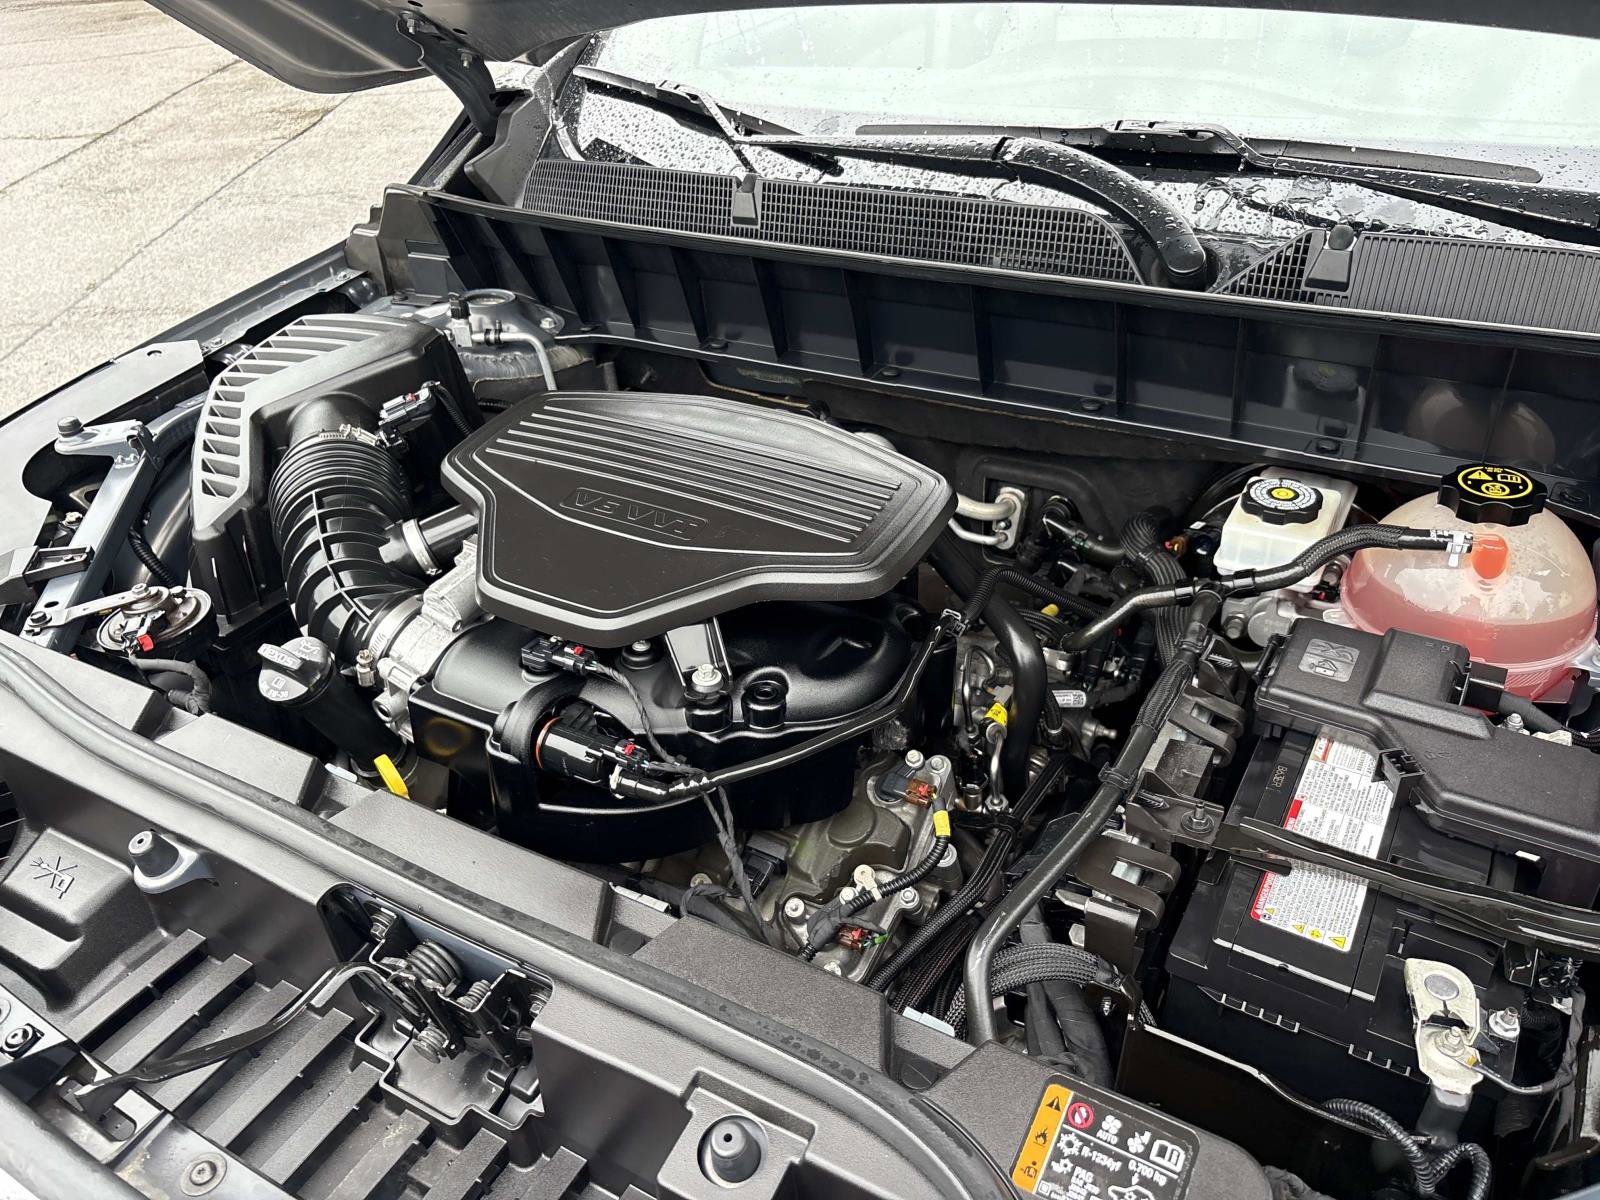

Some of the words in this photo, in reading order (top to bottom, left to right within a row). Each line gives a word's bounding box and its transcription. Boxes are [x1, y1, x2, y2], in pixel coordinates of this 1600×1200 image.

[1096, 1129, 1118, 1145] AUTO
[1080, 1145, 1123, 1172] R-1234yf
[1073, 1166, 1094, 1184] PAG
